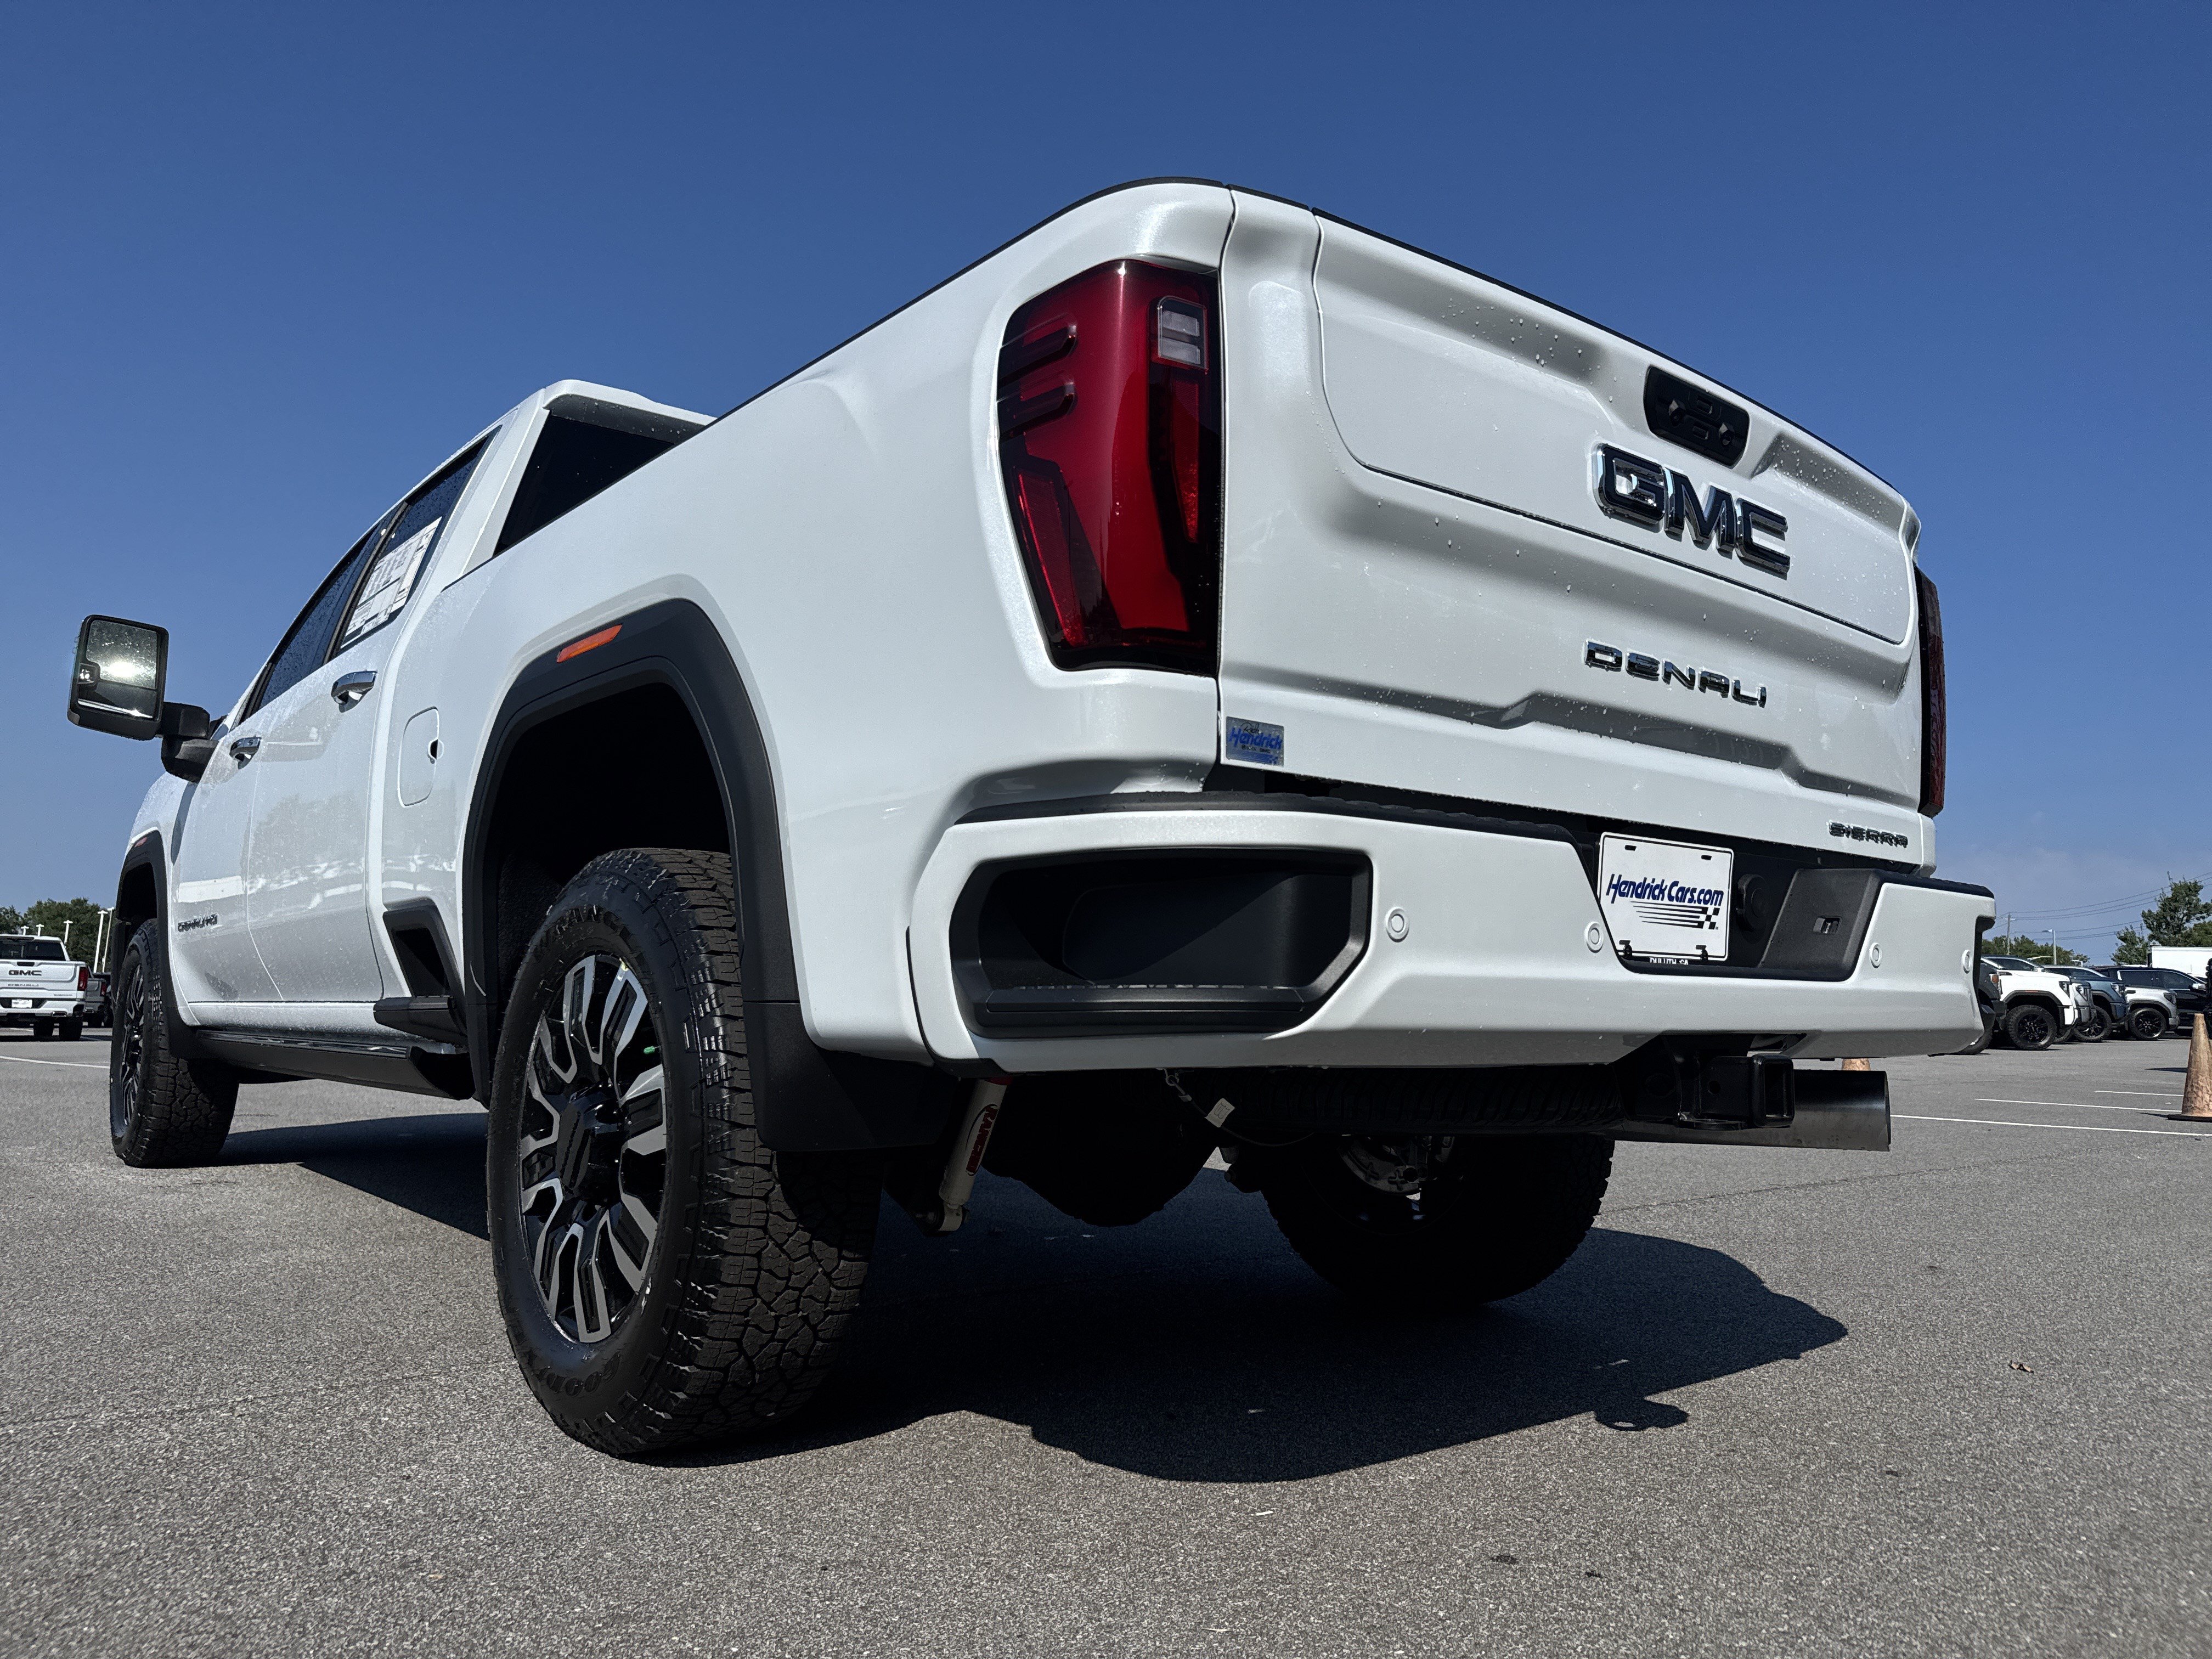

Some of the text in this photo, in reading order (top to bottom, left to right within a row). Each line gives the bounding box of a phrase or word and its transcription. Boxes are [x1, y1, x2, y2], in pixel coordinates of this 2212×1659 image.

[1595, 443, 1791, 574] GMC
[1584, 638, 1768, 708] DENALI
[1229, 727, 1283, 750] Hendrick
[1828, 821, 1908, 848] SIERRA
